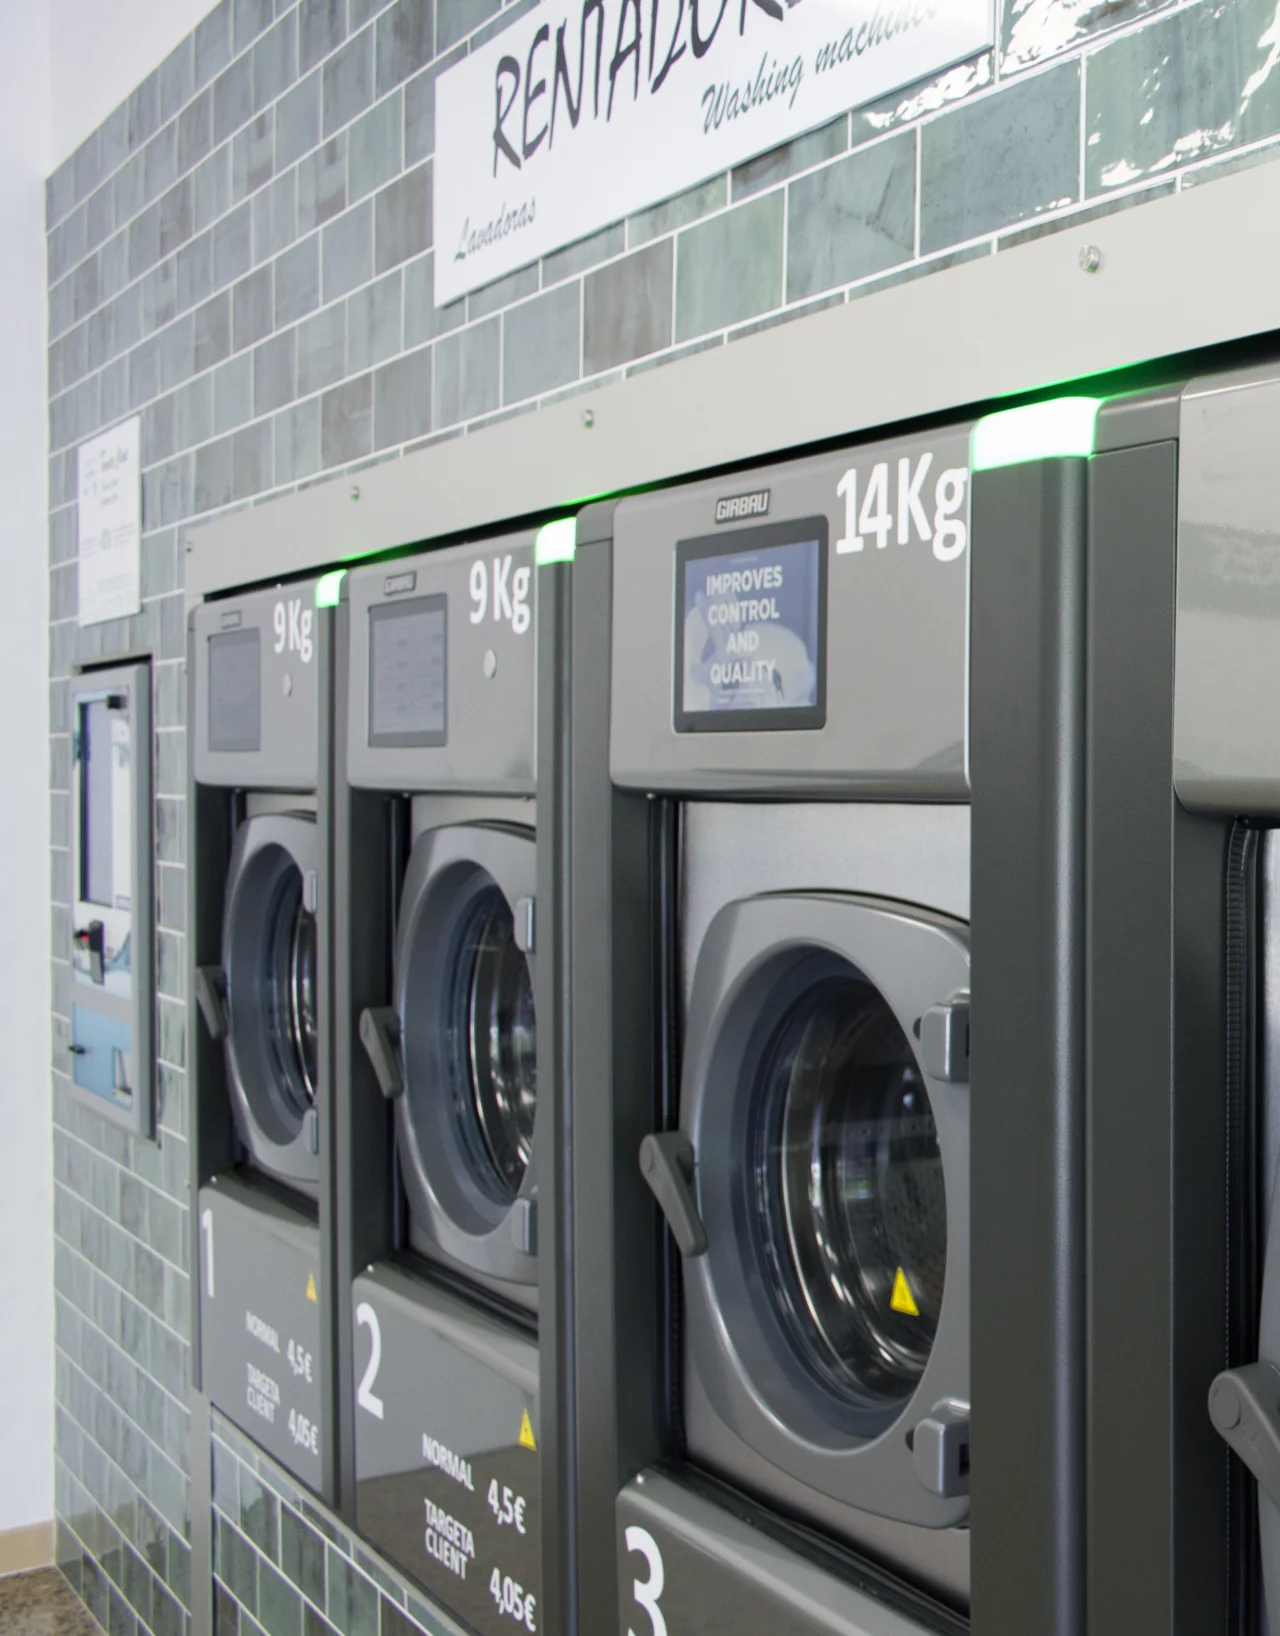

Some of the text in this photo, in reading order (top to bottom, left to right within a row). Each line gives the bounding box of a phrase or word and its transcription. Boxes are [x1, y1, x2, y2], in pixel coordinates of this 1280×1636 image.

[701, 51, 804, 134] Washing
[453, 196, 536, 264] Lavadoras
[716, 491, 770, 521] GIRBAU
[836, 452, 969, 562] 14Kg
[469, 555, 531, 634] 9Kg
[706, 565, 783, 597] IMPROVES
[707, 598, 780, 626] CONTROL
[273, 598, 313, 663] 9Kg
[726, 631, 760, 653] AND
[710, 659, 776, 685] QUALITY
[356, 1302, 384, 1421] 2
[422, 1432, 527, 1535] NORMAL 4,5€
[424, 1497, 475, 1559] TARGETA
[425, 1527, 537, 1633] CLIENT 4,05€
[625, 1525, 668, 1636] 3
